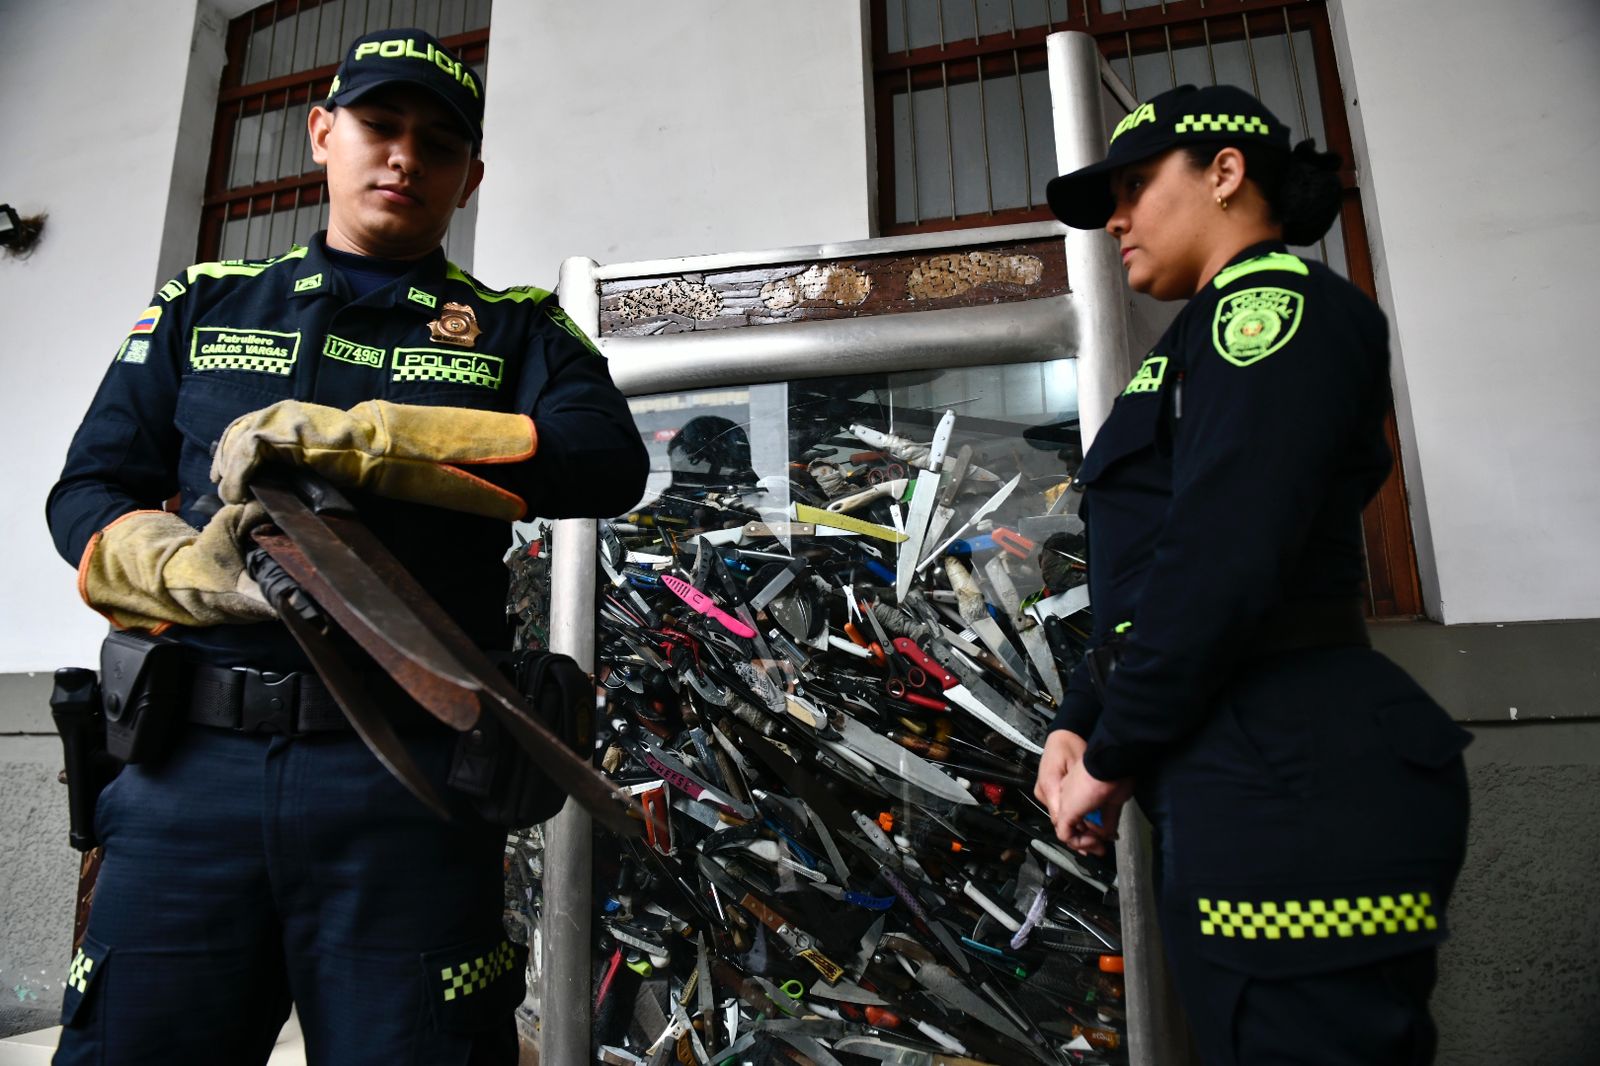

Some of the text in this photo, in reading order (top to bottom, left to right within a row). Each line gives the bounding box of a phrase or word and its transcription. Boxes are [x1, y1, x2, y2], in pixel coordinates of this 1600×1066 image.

[217, 333, 274, 346] Patrullero
[201, 344, 289, 357] CARLOS VARGAS
[330, 340, 380, 364] 177496
[405, 354, 491, 376] POLICÍA
